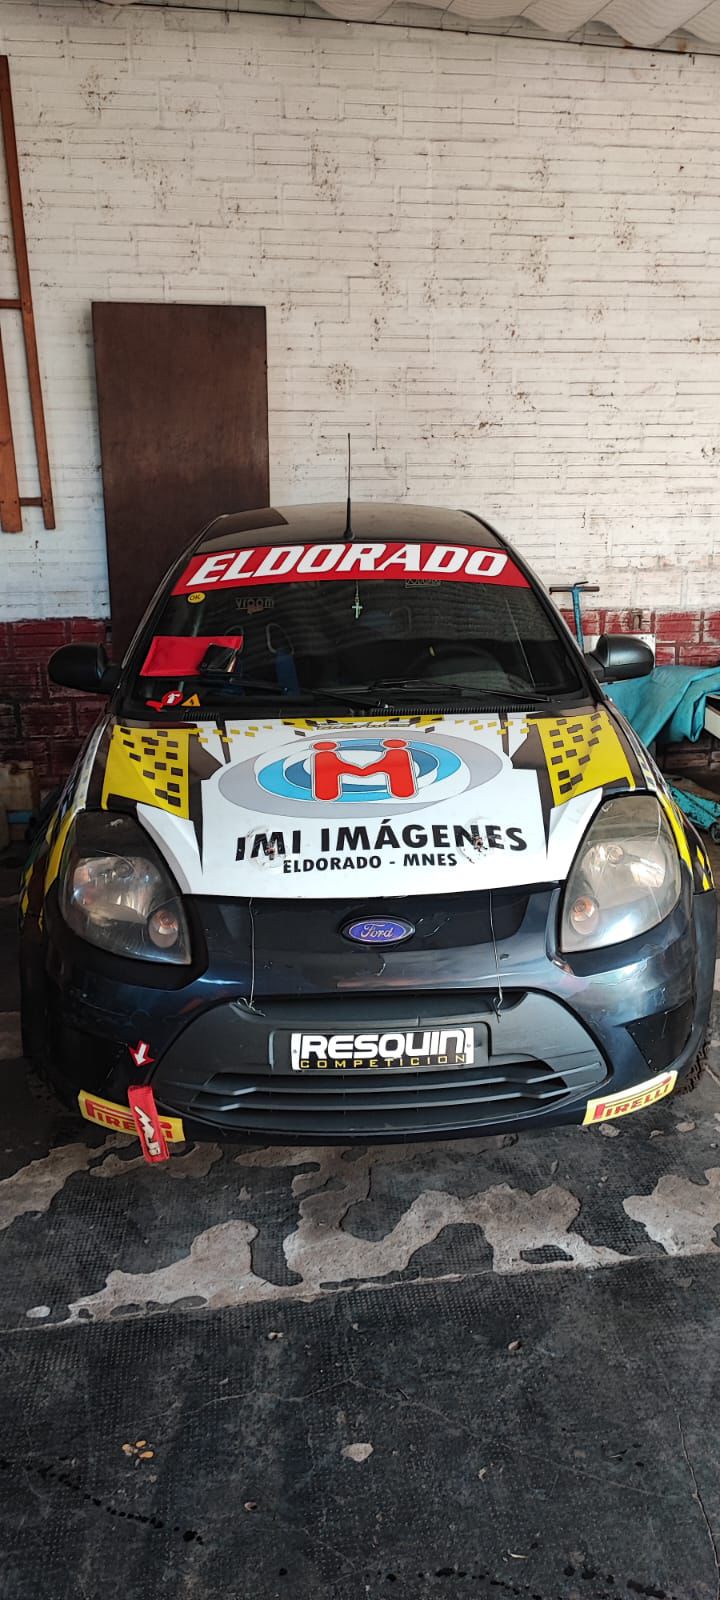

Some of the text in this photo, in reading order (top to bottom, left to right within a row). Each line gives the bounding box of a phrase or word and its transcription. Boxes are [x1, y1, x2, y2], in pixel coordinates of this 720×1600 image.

[186, 543, 509, 587] ELDORADO
[235, 818, 528, 862] IMI IMÁGENES
[282, 855, 382, 874] ELDORADO
[402, 852, 458, 868] MNES
[360, 923, 394, 938] Ford
[300, 1054, 467, 1069] COMPETICION
[301, 1028, 467, 1061] RESQUIN
[593, 1076, 673, 1121] PIRELLI
[84, 1098, 174, 1139] PIREI
